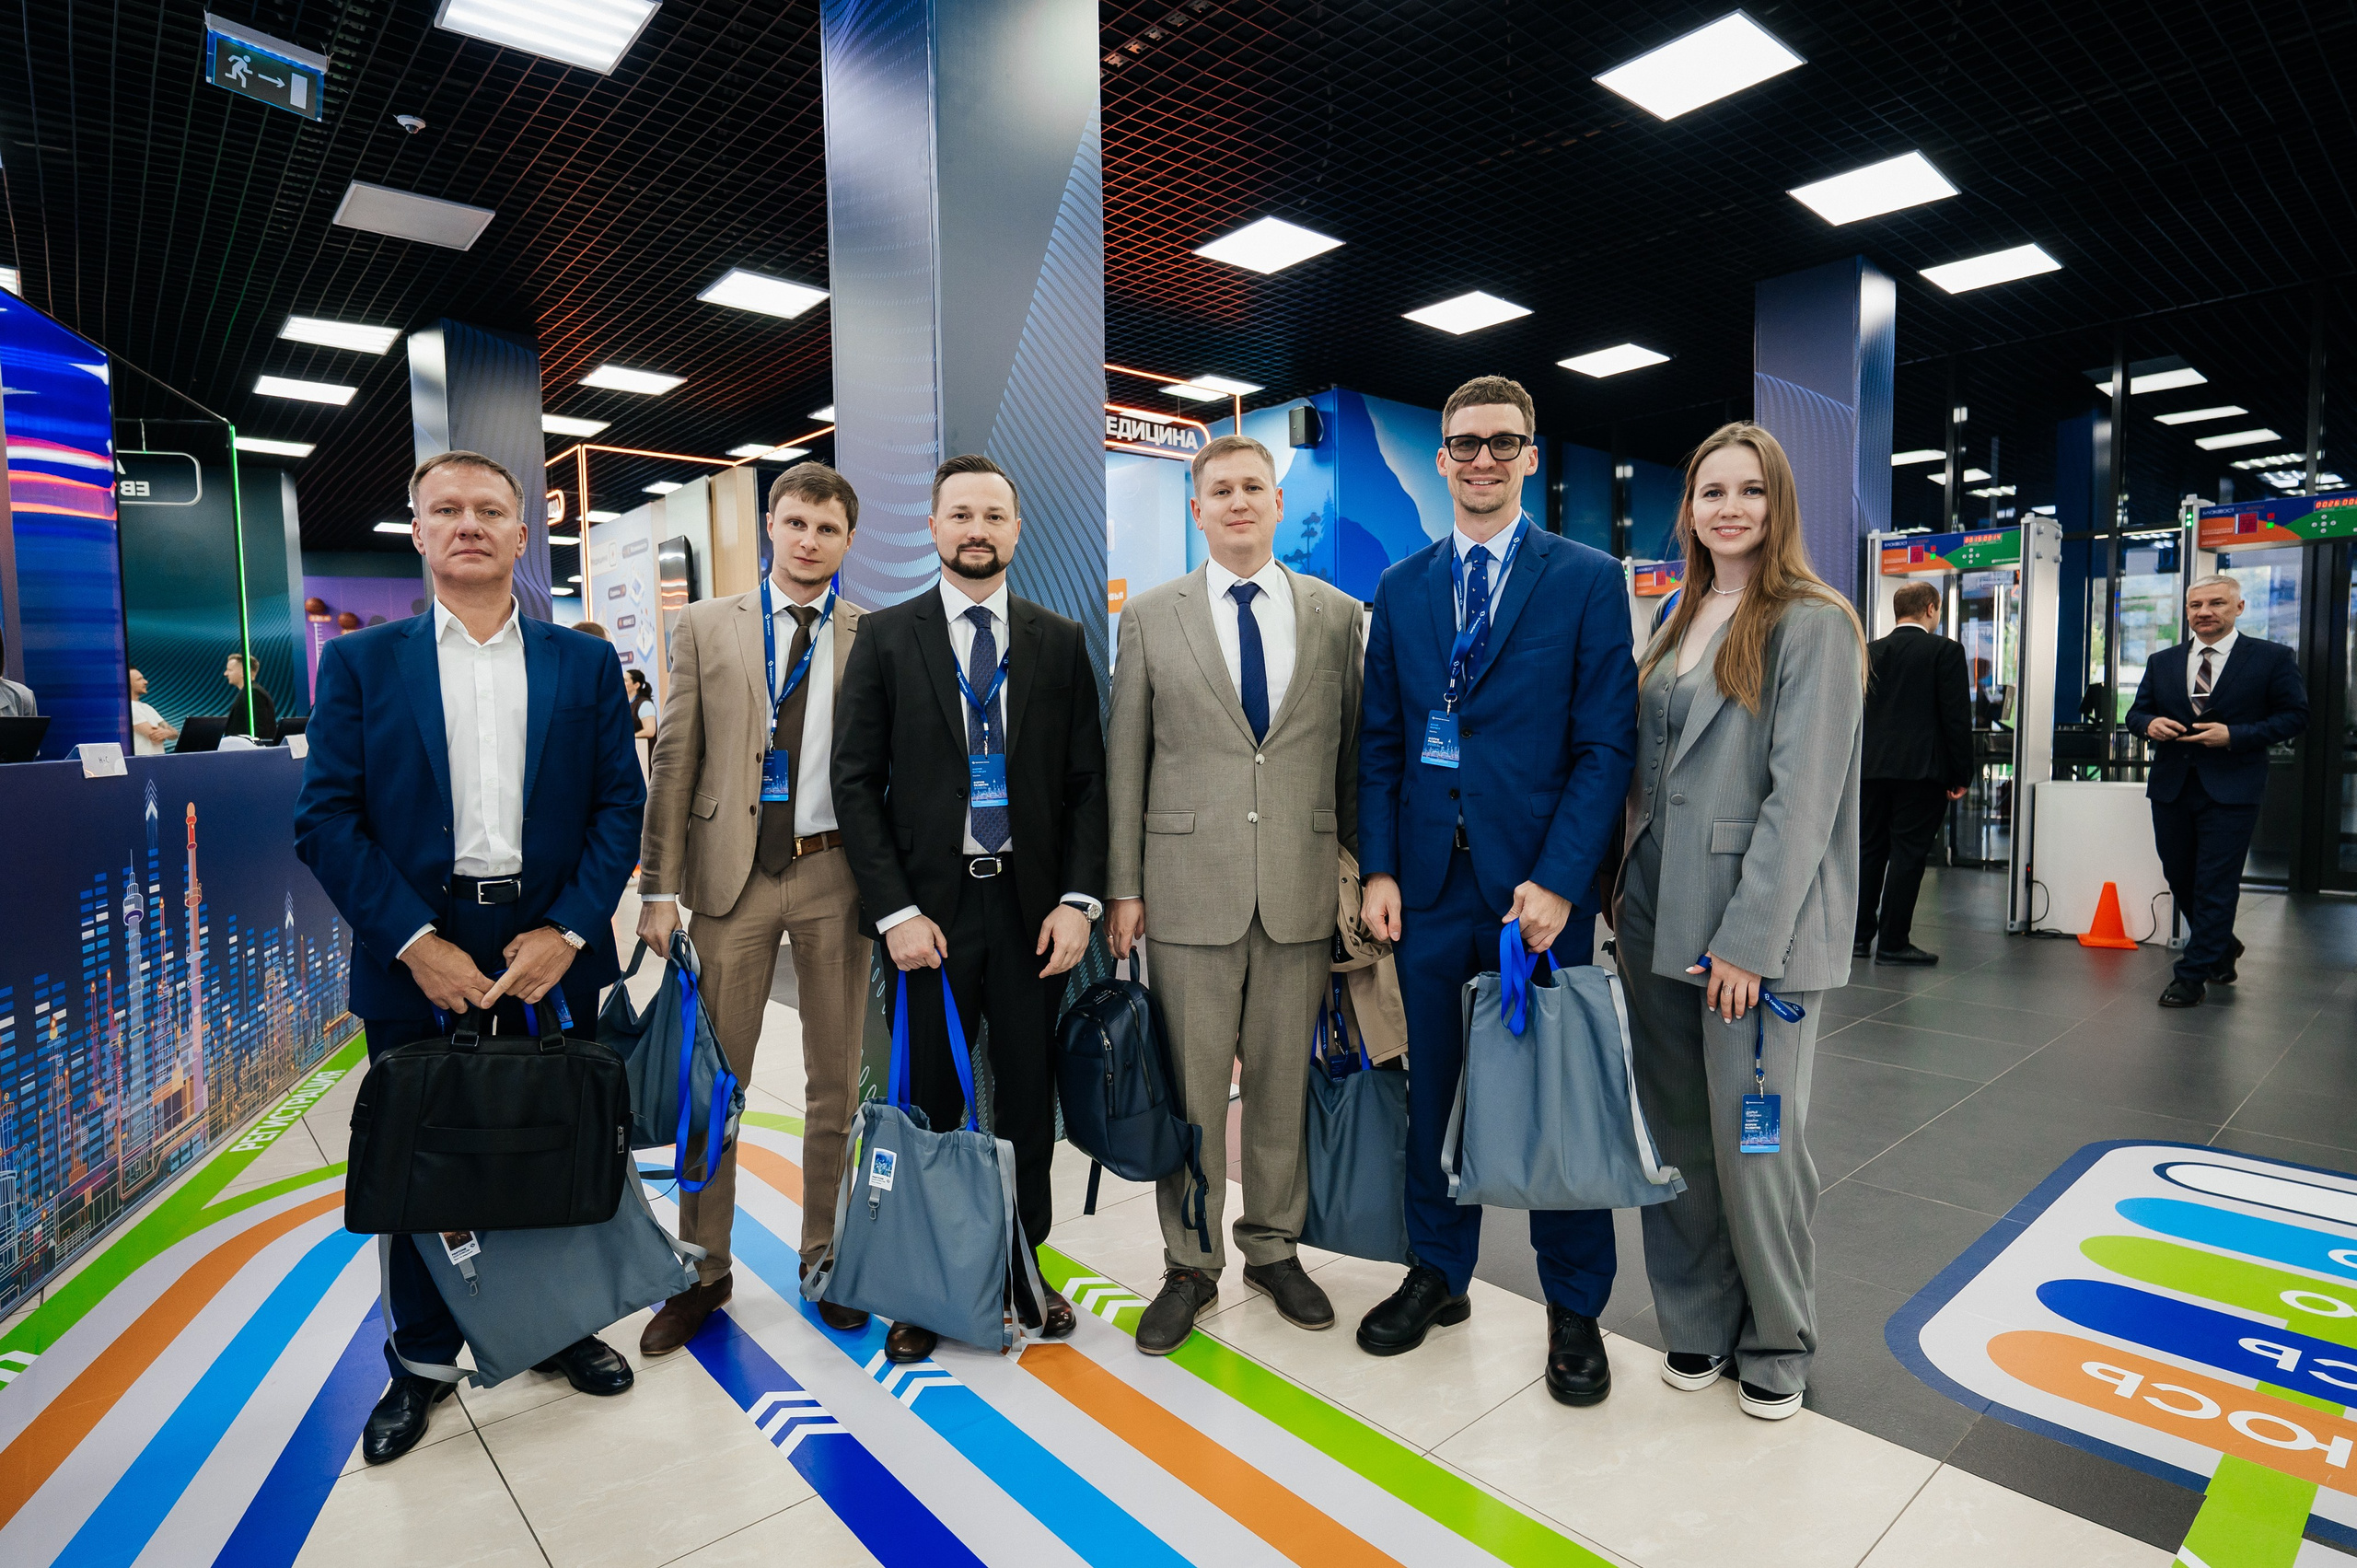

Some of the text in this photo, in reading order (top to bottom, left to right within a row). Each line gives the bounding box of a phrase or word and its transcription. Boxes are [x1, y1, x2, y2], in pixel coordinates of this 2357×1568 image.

[1105, 414, 1199, 450] ЕДИЦИНА
[228, 1069, 347, 1153] РЕГИСТРАЦИЯ
[2081, 1361, 2353, 1469] ЮСЬ
